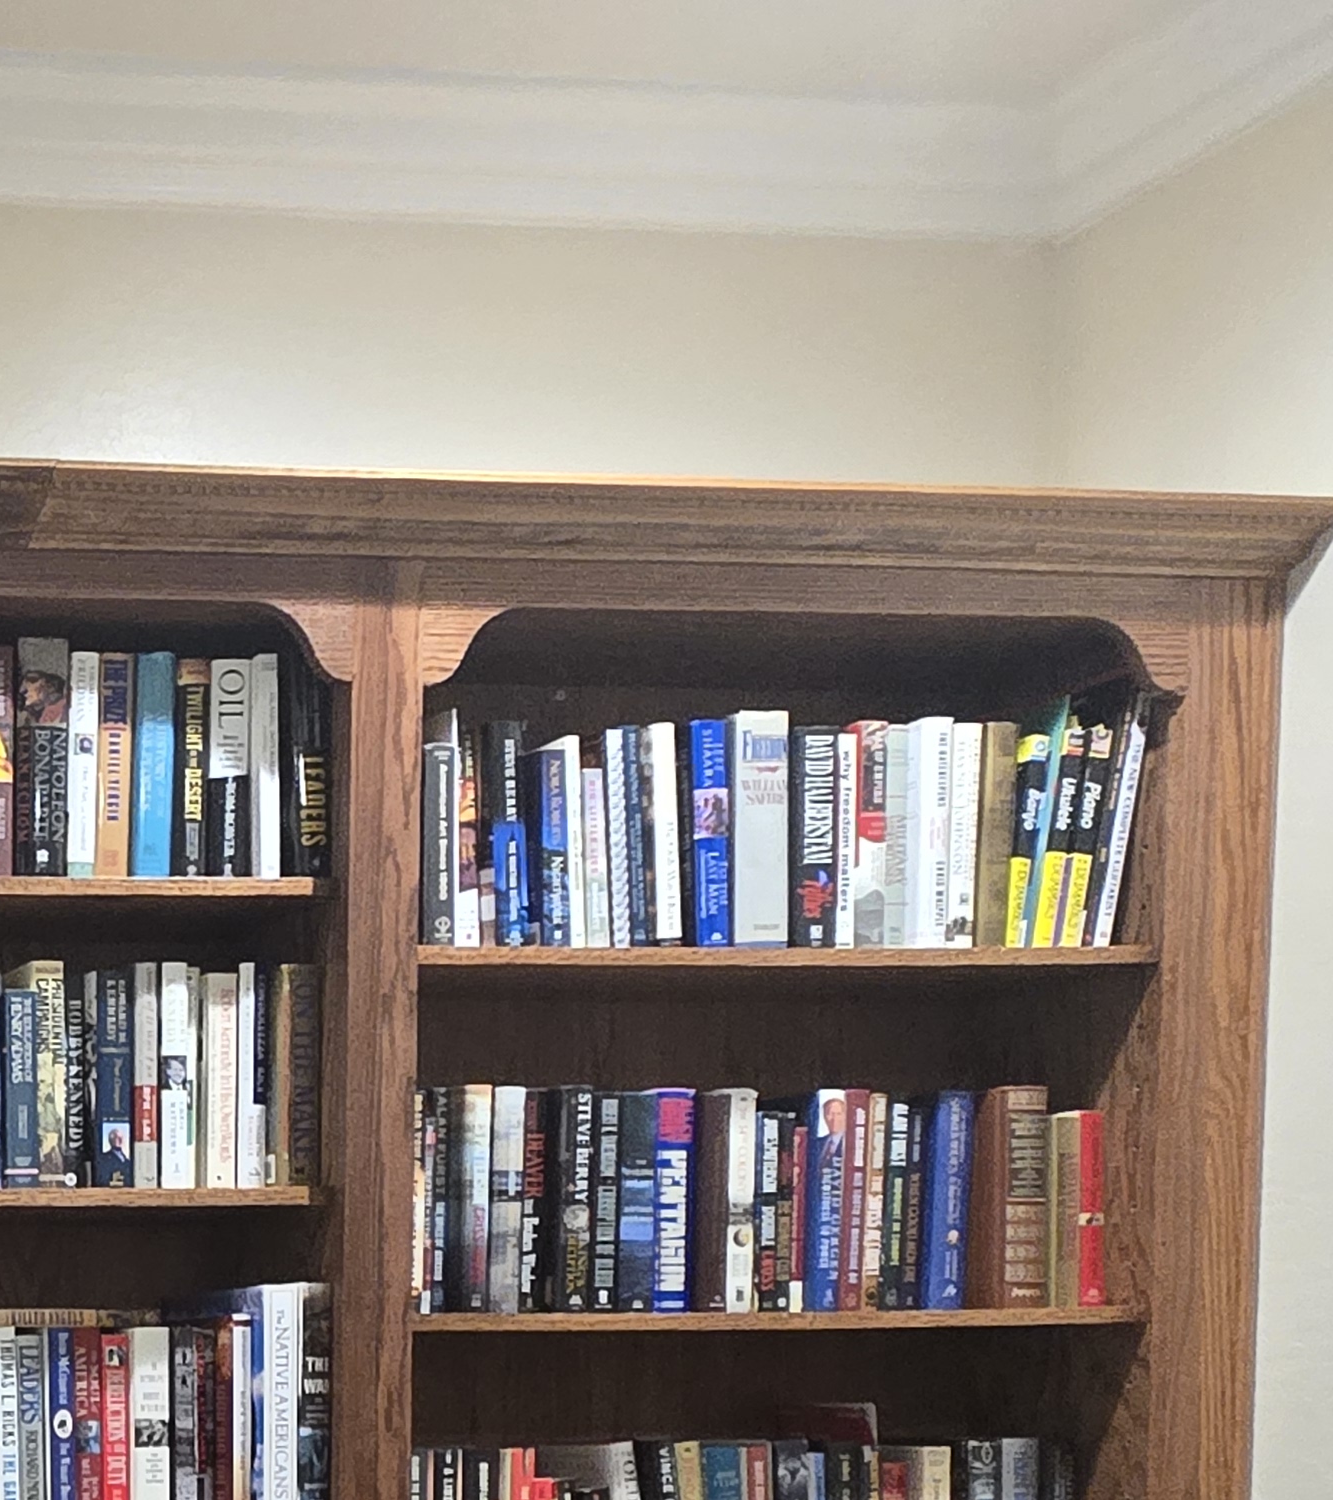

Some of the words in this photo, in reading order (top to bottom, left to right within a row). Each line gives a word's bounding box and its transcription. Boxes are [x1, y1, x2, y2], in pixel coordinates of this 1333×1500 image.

[218, 670, 245, 729] OIL
[52, 731, 66, 842] NAPOLEON
[839, 751, 852, 780] why
[842, 787, 852, 848] freedom
[1021, 789, 1044, 830] Banjo
[1055, 778, 1076, 831] Ukulele
[1080, 783, 1102, 829] Piano
[0, 1339, 15, 1387] THOMAS
[19, 1344, 42, 1425] LEADERS
[274, 1327, 290, 1390] NATIVE
[2, 1410, 16, 1446] RICKS
[274, 1394, 289, 1499] AMERICANS
